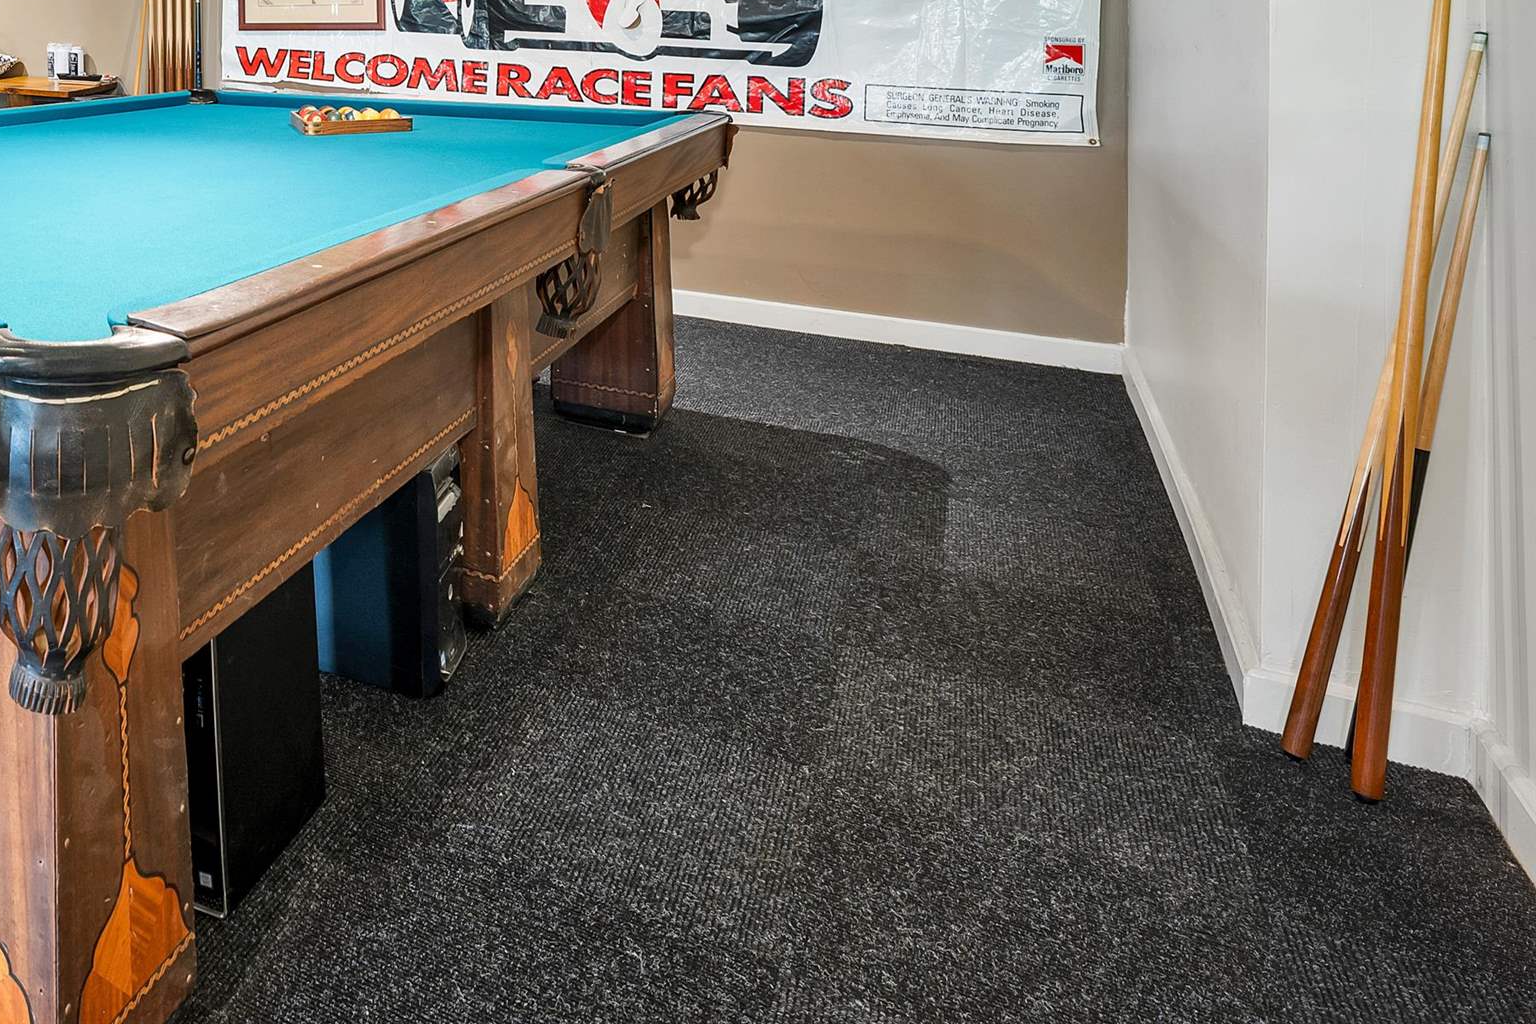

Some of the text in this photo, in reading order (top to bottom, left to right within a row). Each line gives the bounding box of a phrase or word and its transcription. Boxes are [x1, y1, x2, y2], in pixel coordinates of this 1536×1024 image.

[1045, 64, 1084, 74] Marlboro
[235, 46, 854, 119] WELCOME RACE FANS
[887, 101, 917, 110] Causes
[923, 104, 943, 113] Lung
[949, 104, 982, 115] Cancer,
[988, 107, 1014, 116] Heart
[1025, 99, 1060, 110] Smoking
[934, 113, 950, 122] And
[952, 114, 969, 124] May
[972, 115, 1015, 126] Complicate
